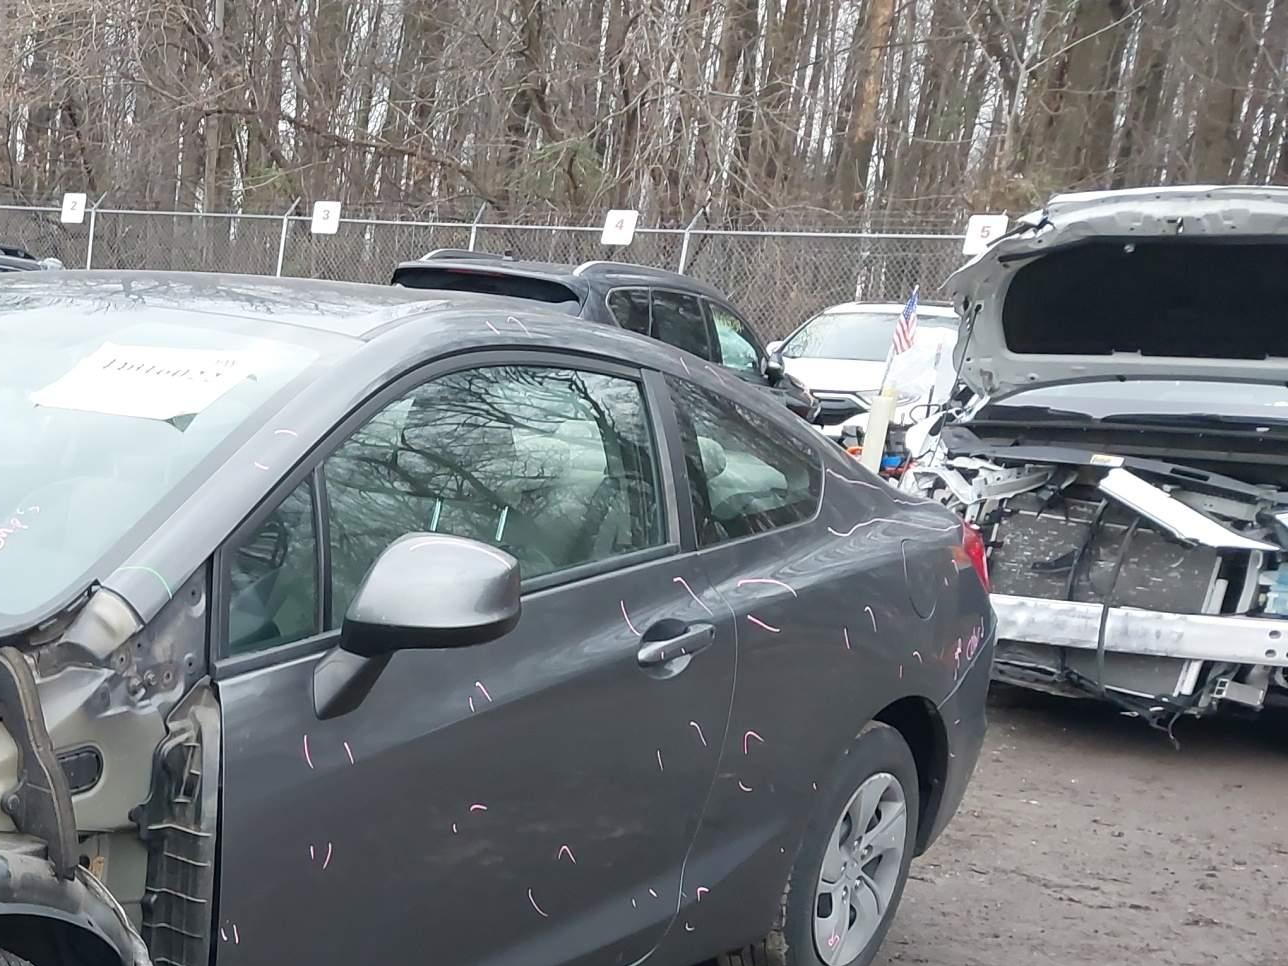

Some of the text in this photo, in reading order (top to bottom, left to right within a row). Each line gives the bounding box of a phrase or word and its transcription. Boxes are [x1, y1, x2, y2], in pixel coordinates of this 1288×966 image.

[70, 200, 78, 211] 2
[322, 209, 330, 220] 3
[615, 218, 625, 231] 4
[980, 225, 992, 238] 5
